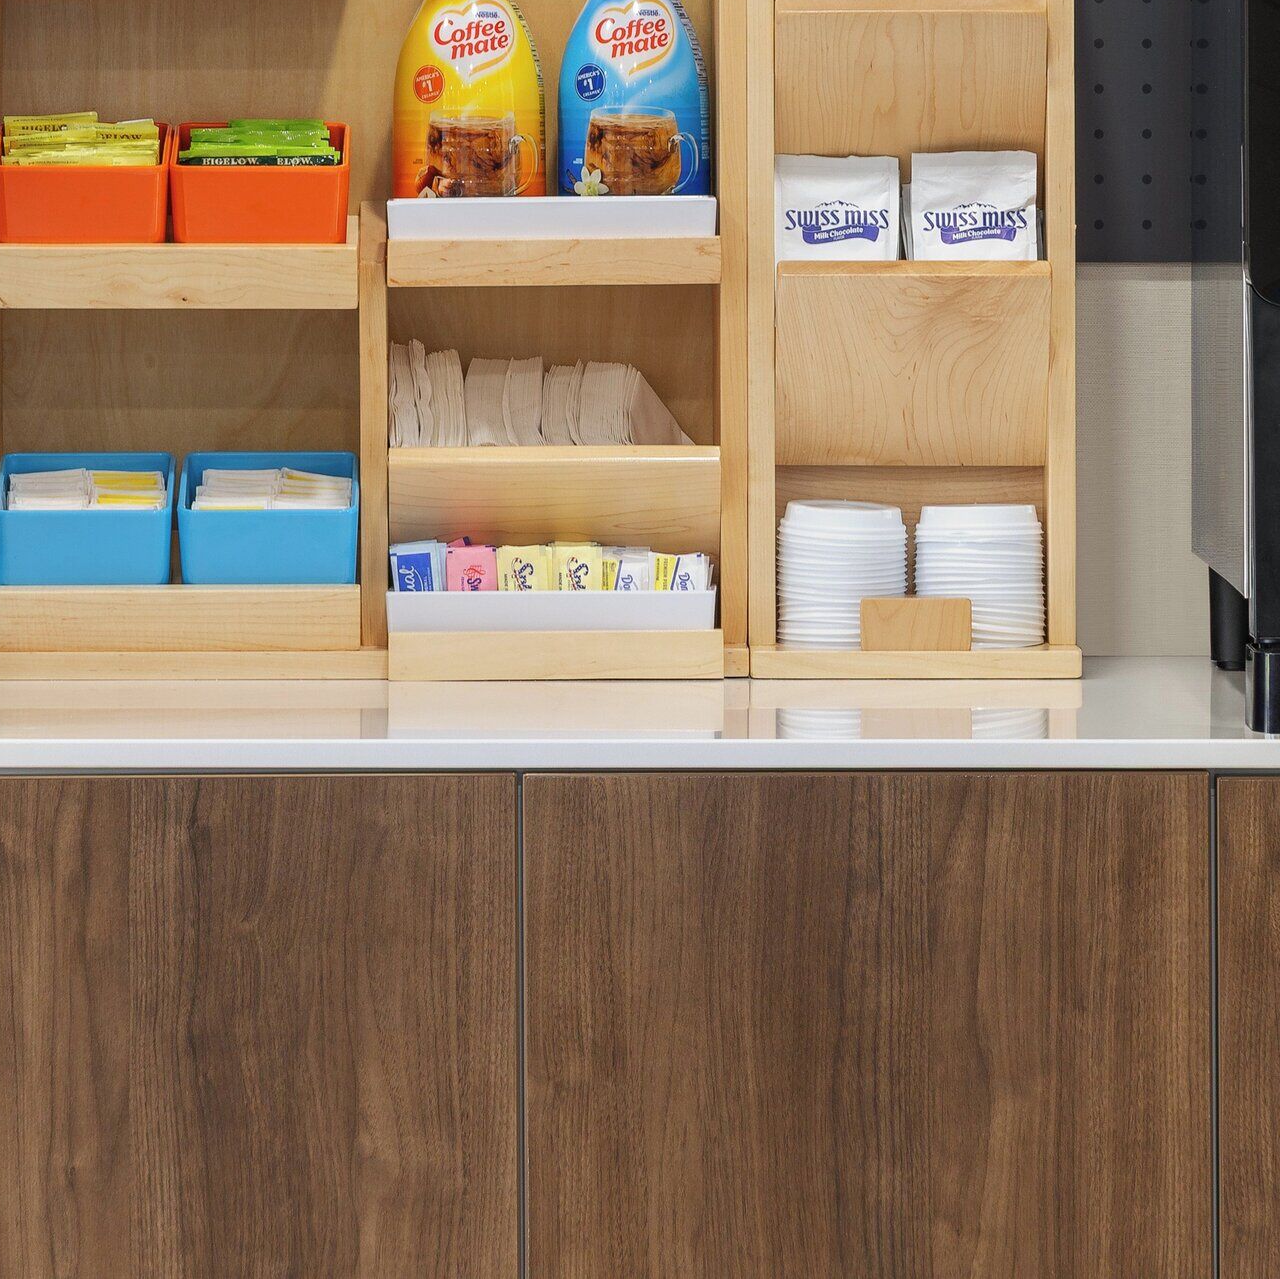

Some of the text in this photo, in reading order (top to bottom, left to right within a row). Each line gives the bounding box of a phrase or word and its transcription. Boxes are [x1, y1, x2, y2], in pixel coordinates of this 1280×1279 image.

[434, 19, 506, 46] Coffee
[595, 17, 666, 44] Coffee
[451, 34, 509, 60] mate
[611, 32, 669, 58] mate
[814, 231, 829, 240] Milk
[829, 226, 864, 239] Chocolate
[952, 227, 1001, 240] Milk Chocolate
